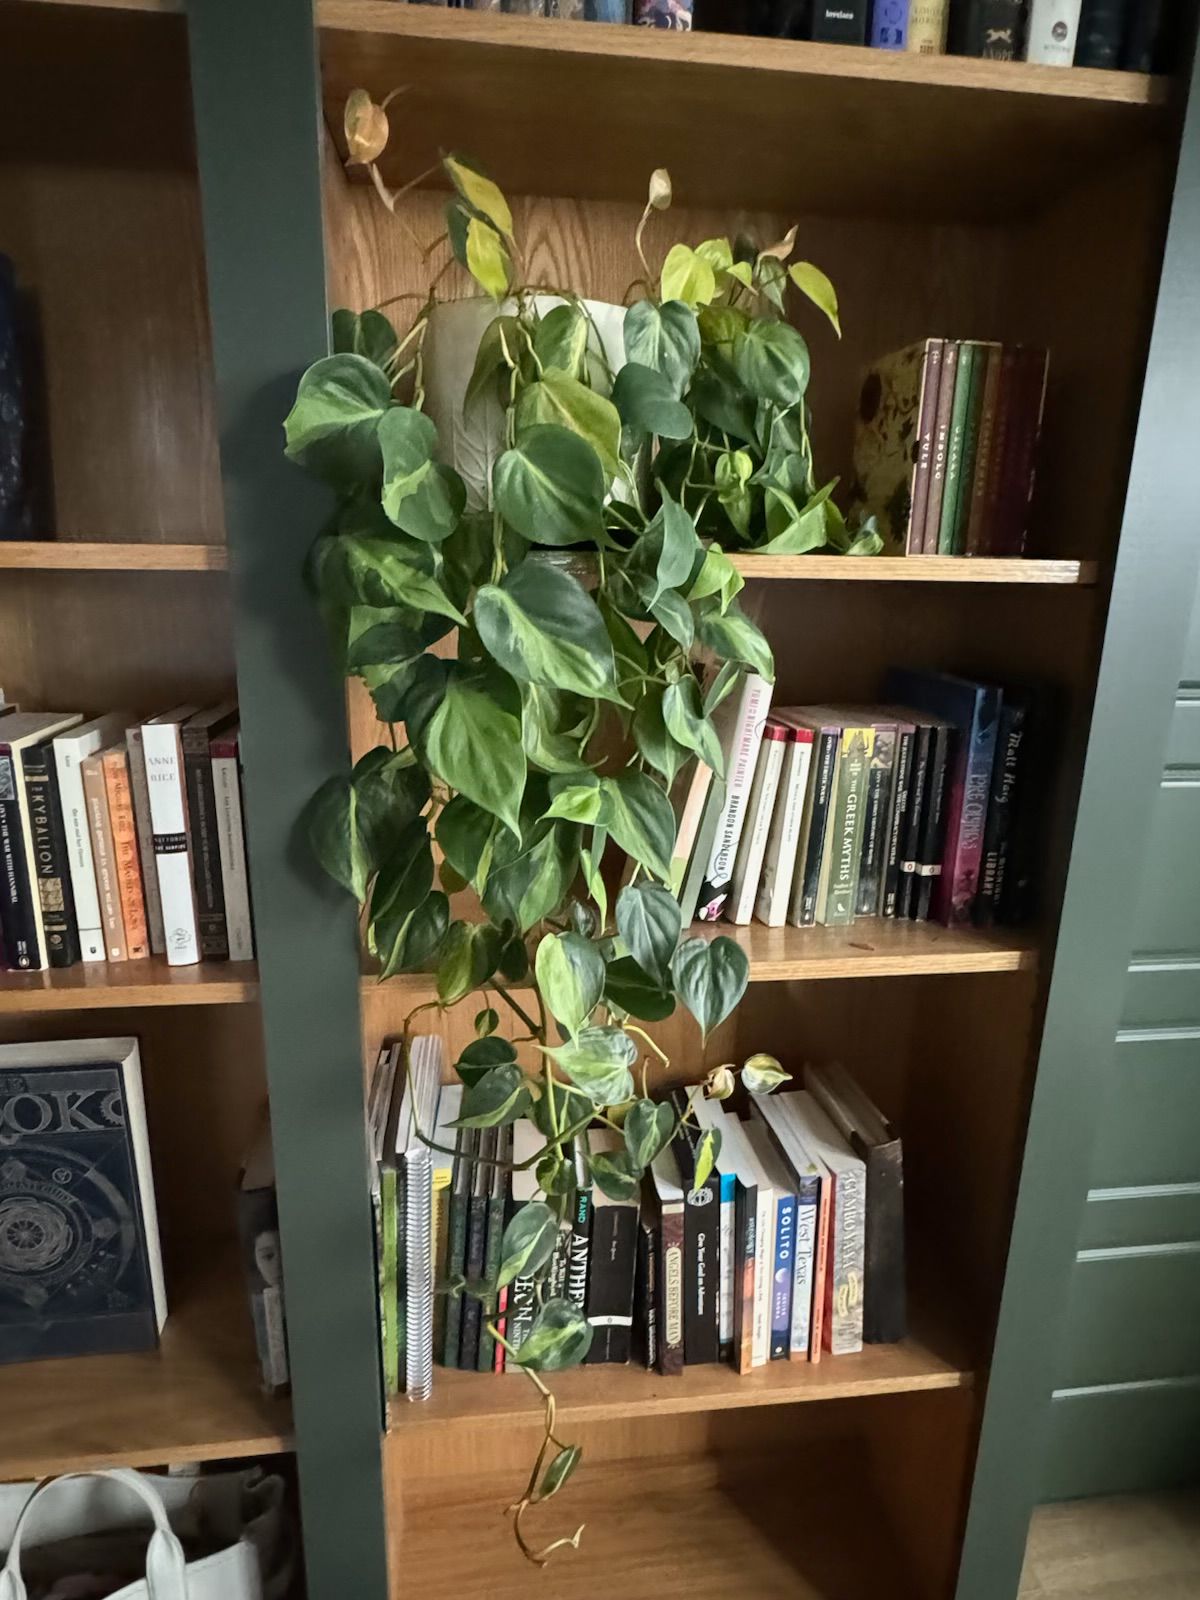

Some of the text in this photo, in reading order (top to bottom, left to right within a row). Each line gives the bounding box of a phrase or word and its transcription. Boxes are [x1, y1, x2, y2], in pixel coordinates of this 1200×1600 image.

[733, 758, 747, 787] PAINTER
[995, 731, 1023, 803] Matt Haig
[32, 794, 53, 873] KYBALION
[716, 795, 740, 870] BRANDON SANDERSON
[843, 794, 858, 836] GREEK
[3, 838, 11, 852] WAR
[5, 853, 14, 870] WITH
[838, 837, 853, 880] MYTHS
[8, 871, 18, 903] HANNIBAL
[981, 852, 997, 895] LIBRARY
[577, 1196, 587, 1224] RAND
[778, 1206, 792, 1259] SOLITO
[795, 1207, 814, 1285] West Texas
[568, 1232, 589, 1309] ANTHE
[668, 1251, 678, 1341] ANGELS BEFORE MAN
